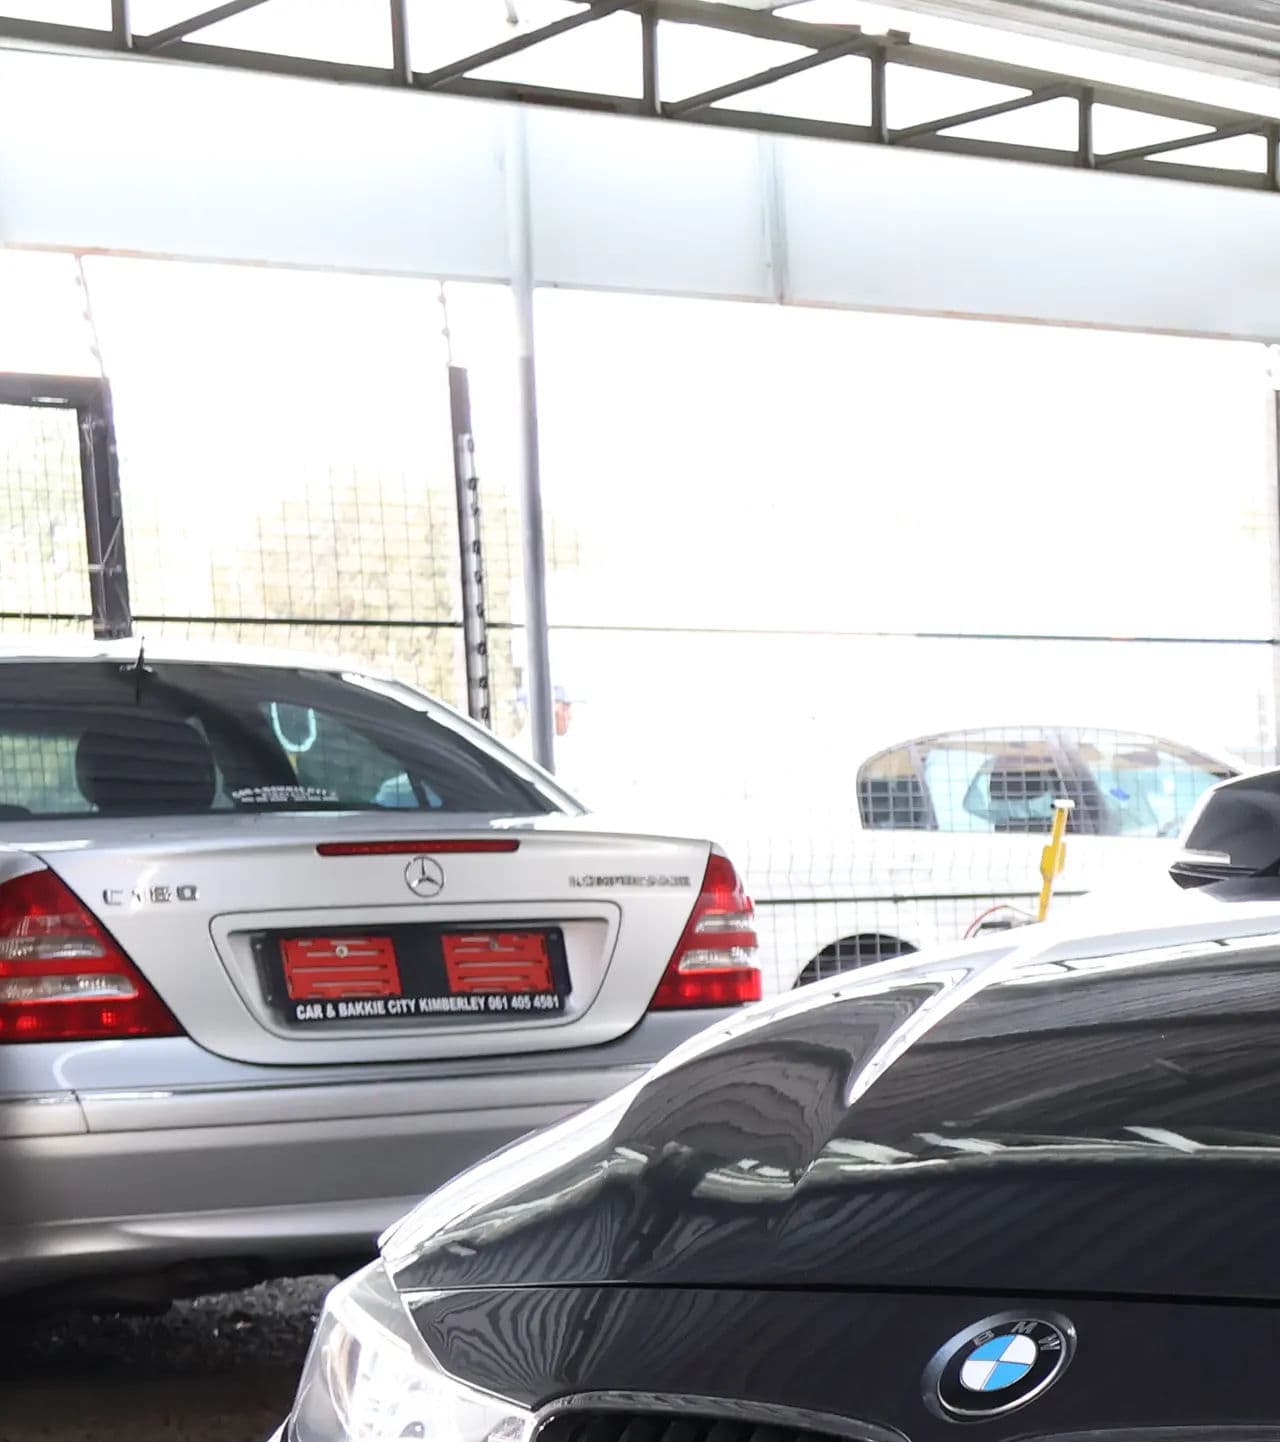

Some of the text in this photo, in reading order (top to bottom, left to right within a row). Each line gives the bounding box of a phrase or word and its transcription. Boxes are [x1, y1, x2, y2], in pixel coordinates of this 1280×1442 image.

[296, 1003, 323, 1020] CAR
[326, 1003, 336, 1018] &
[338, 1000, 386, 1018] BAKKIE
[387, 998, 416, 1014] CITY
[419, 995, 486, 1013] KIMBERLEY
[972, 1320, 1061, 1351] BMW
